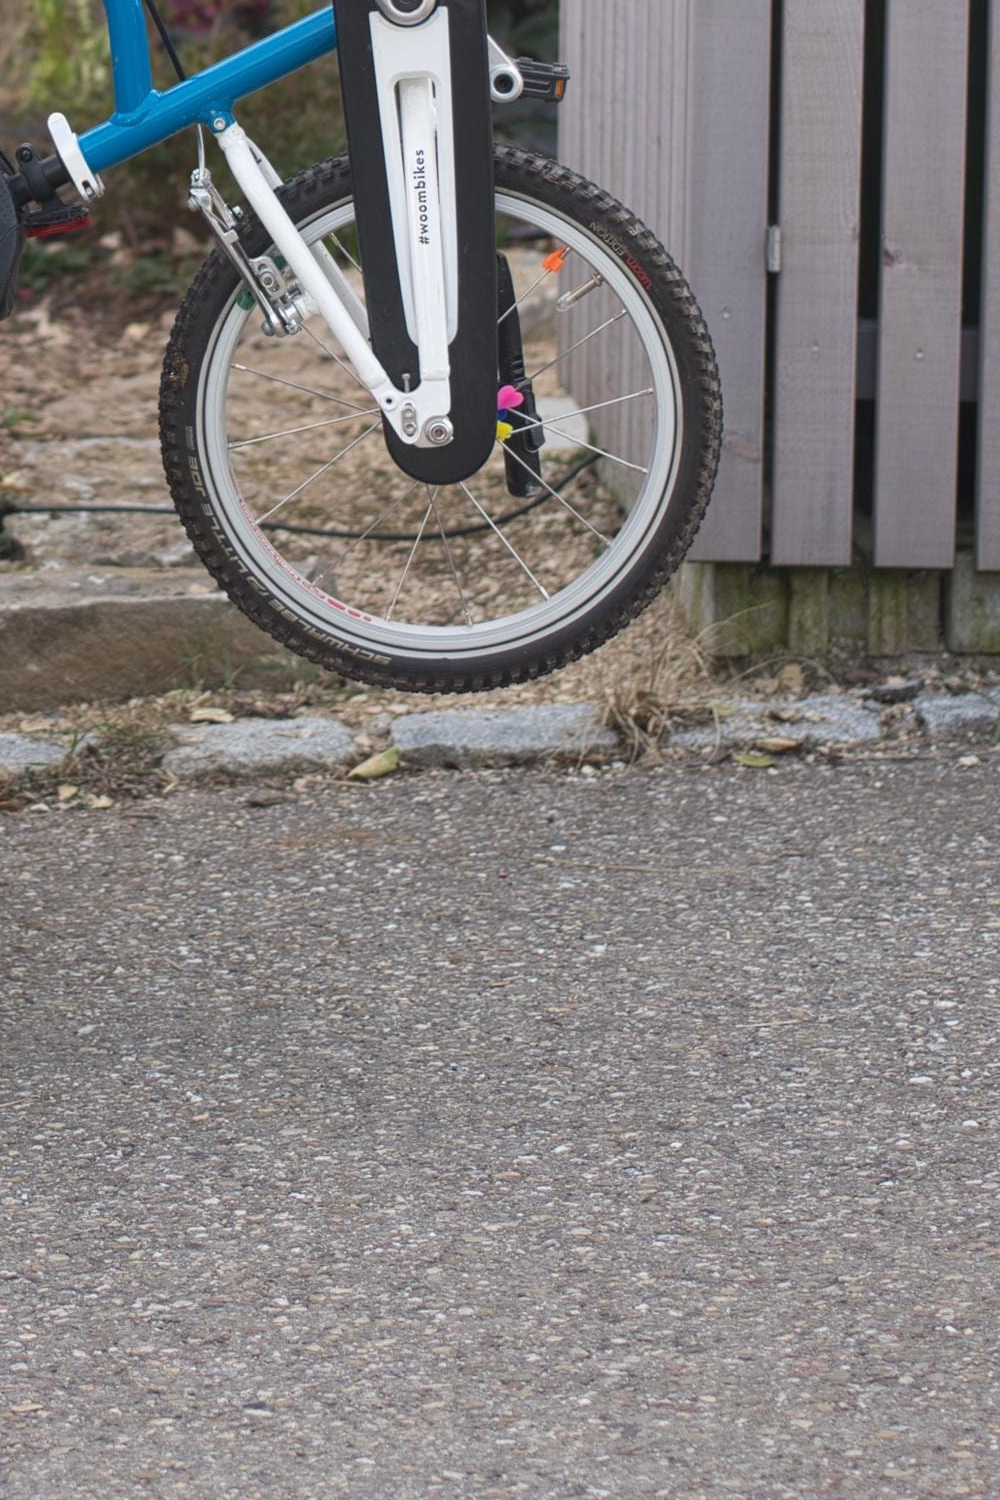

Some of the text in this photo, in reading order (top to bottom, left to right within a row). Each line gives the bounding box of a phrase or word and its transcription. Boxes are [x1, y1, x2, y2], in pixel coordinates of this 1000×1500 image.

[413, 148, 430, 245] #woombikes
[588, 221, 625, 256] EDITION
[187, 455, 207, 498] JOE
[201, 502, 250, 574] LITTLE
[267, 598, 393, 666] SCHWALBE
